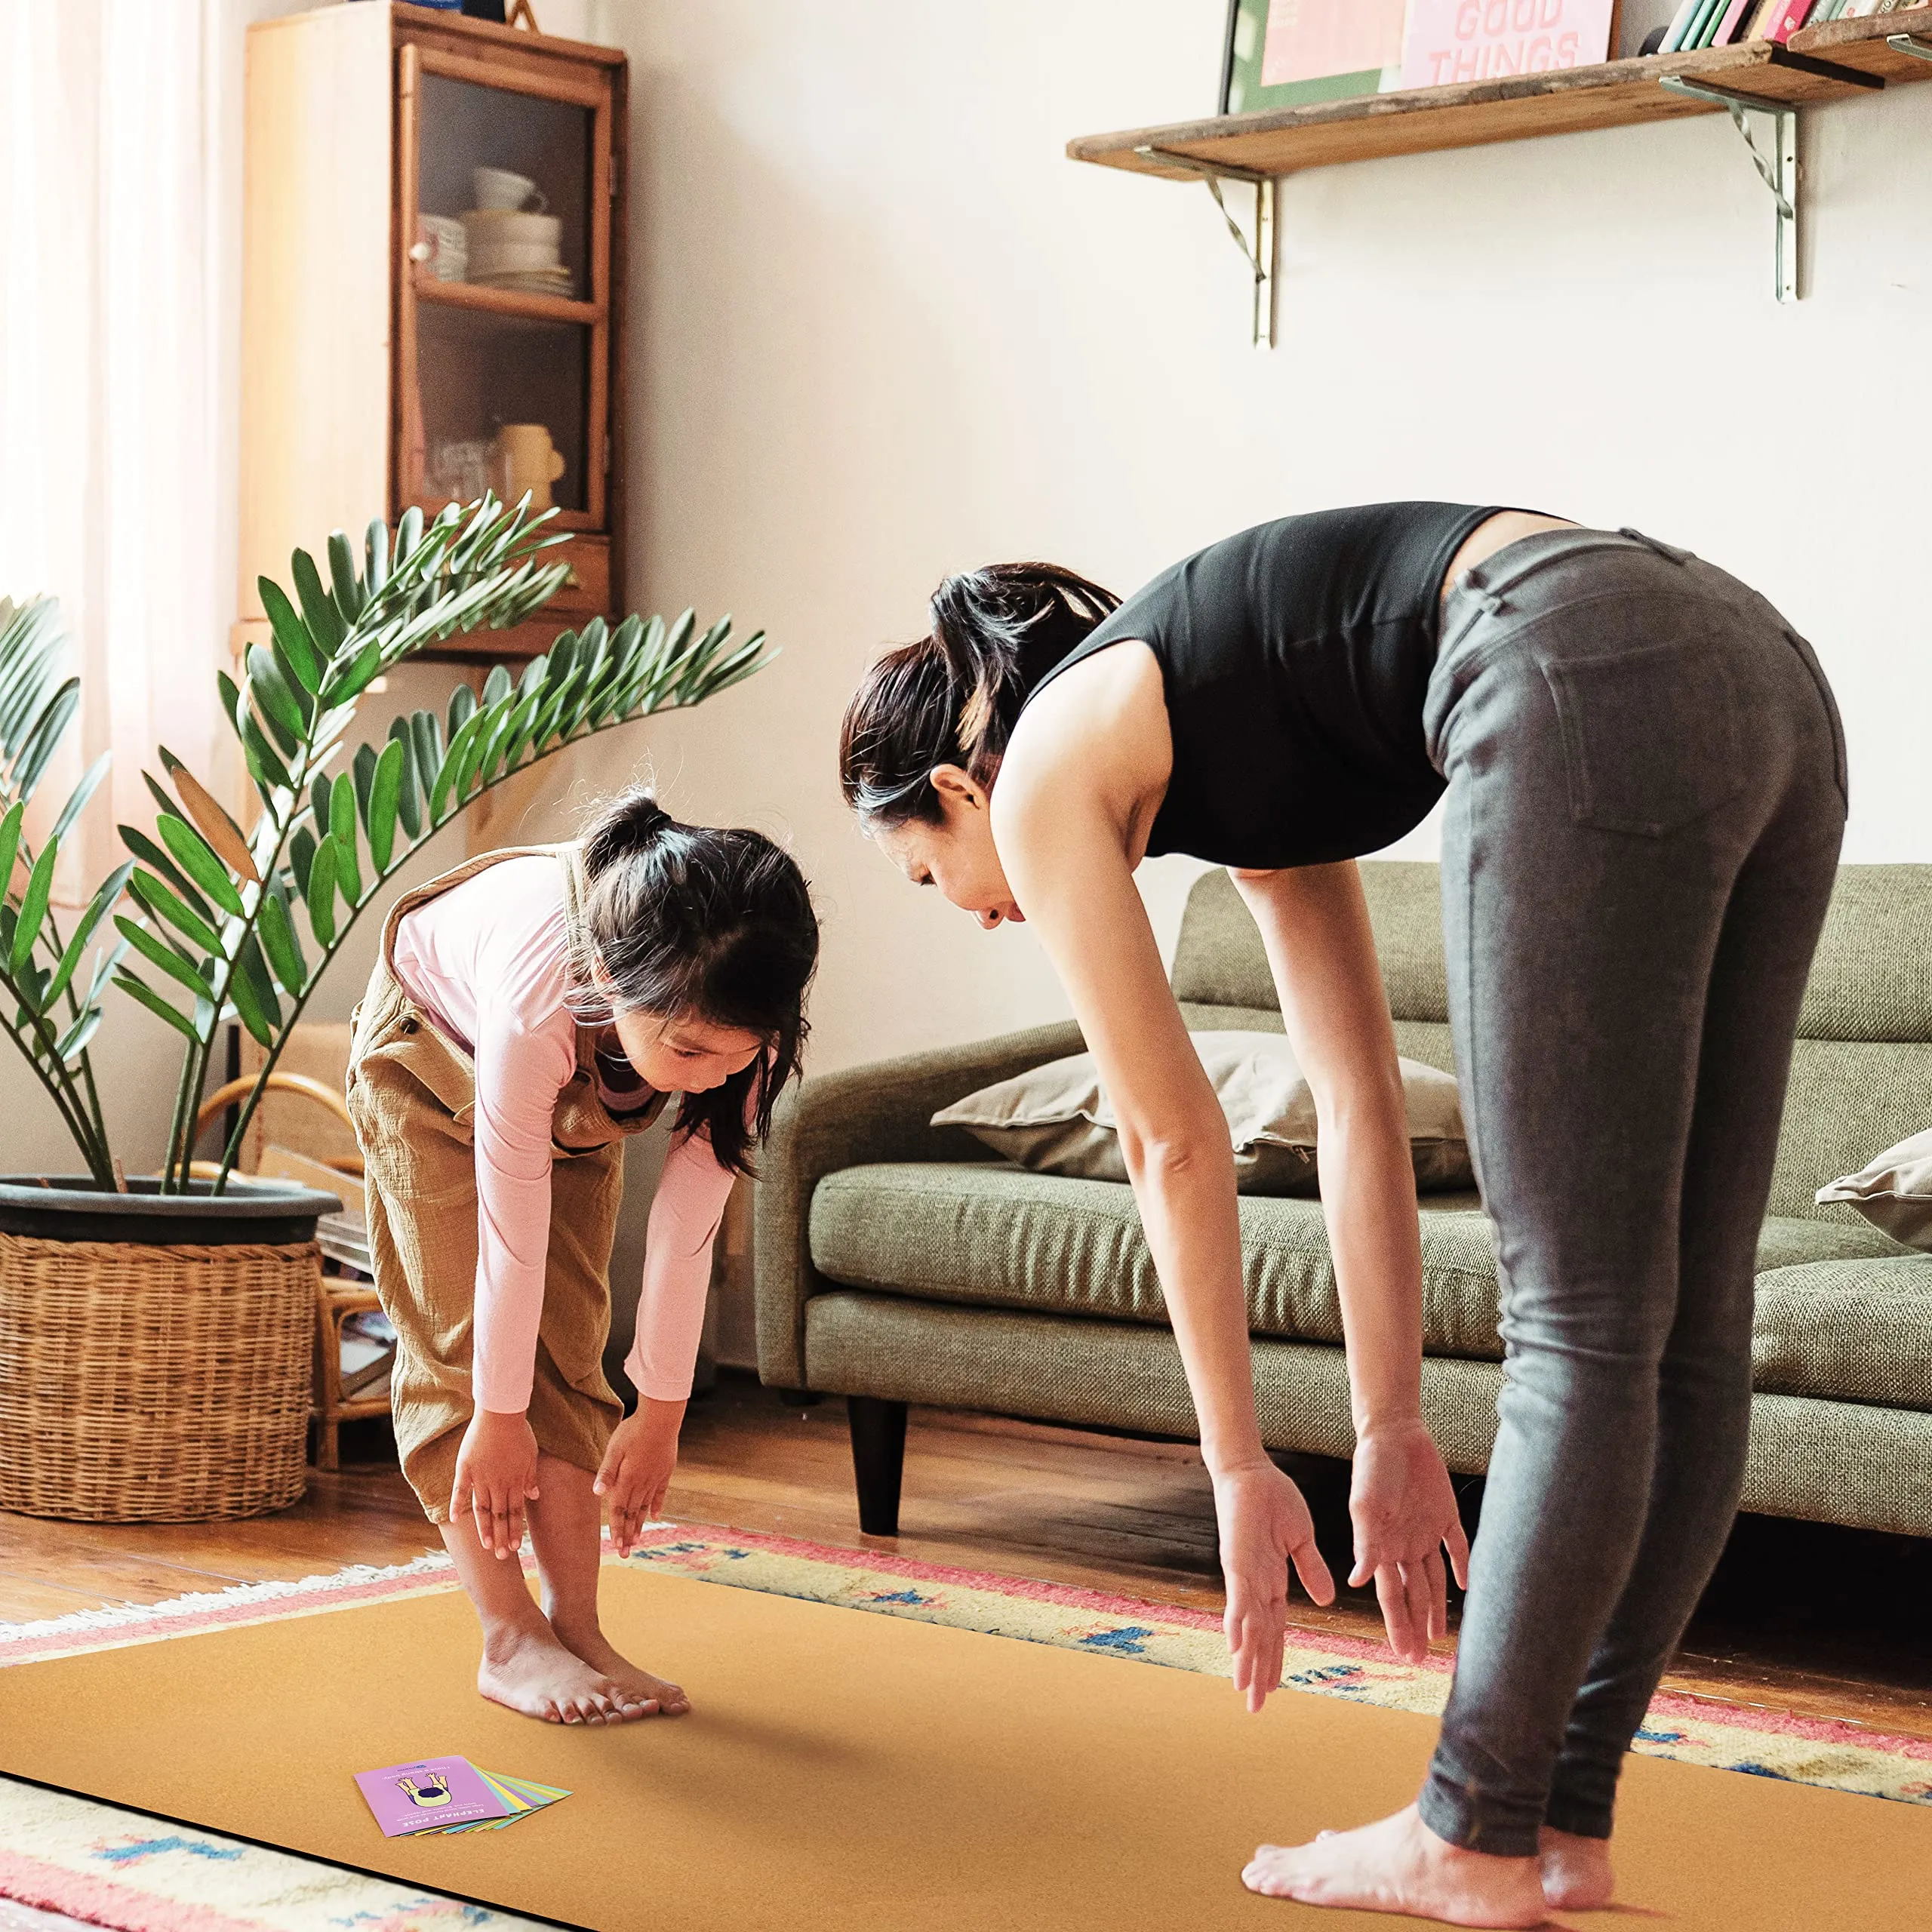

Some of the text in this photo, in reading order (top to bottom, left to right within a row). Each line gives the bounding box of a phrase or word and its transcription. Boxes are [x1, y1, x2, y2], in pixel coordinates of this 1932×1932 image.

[1454, 0, 1563, 41] GOOD
[1428, 32, 1578, 87] THINGS
[402, 1817, 429, 1827] POSE
[434, 1808, 485, 1820] ELEPHANT
